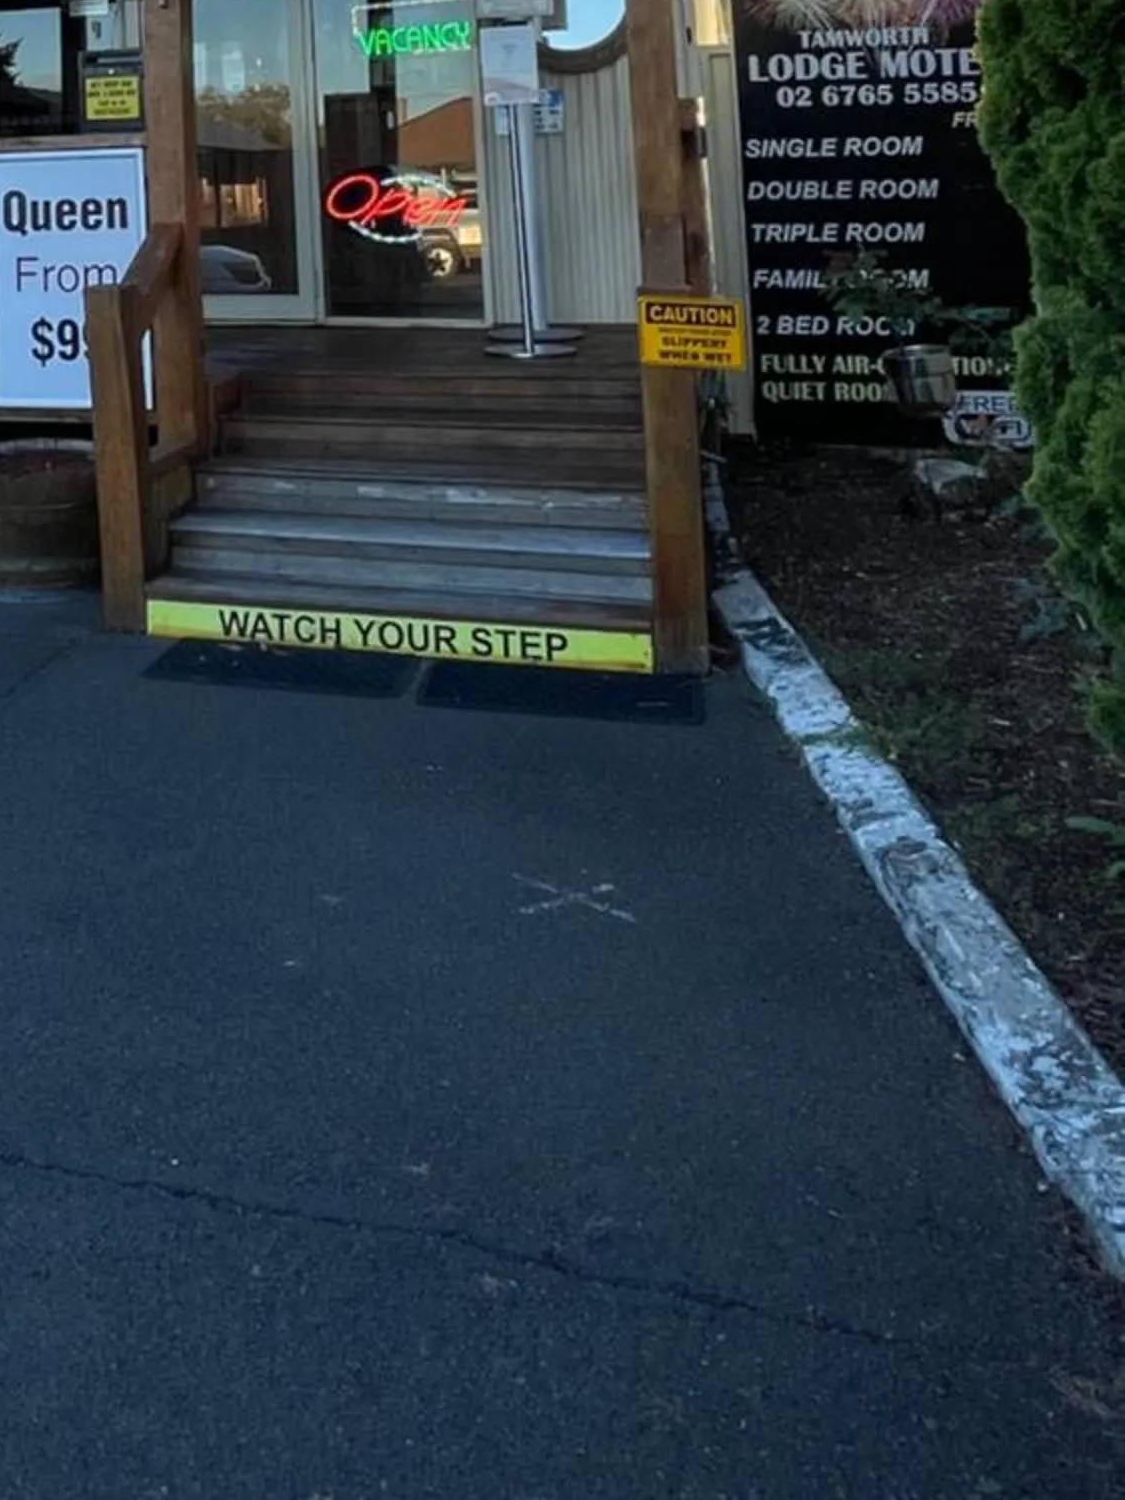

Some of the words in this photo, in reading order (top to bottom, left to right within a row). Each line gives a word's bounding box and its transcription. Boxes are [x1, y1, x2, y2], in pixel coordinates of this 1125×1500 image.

[357, 21, 470, 55] VACANCY
[799, 26, 930, 49] TAMWORTH
[747, 53, 869, 83] LODGE
[879, 48, 981, 78] MOTE
[776, 86, 814, 107] 02
[820, 84, 894, 106] 6765
[903, 81, 977, 104] 5585
[951, 111, 976, 129] FR
[745, 137, 837, 158] SINGLE
[842, 135, 924, 157] ROOM
[326, 173, 468, 227] Open
[747, 179, 854, 200] DOUBLE
[858, 178, 940, 199] ROOM
[2, 190, 129, 237] Queen
[751, 223, 839, 243] TRIPLE
[844, 221, 926, 243] ROOM
[16, 257, 118, 293] From
[753, 269, 839, 290] FAMIL
[650, 305, 733, 325] CAUTION
[756, 315, 771, 335] 2
[776, 314, 829, 336] BED
[31, 317, 88, 367] $9
[761, 354, 826, 374] FULLY
[762, 381, 827, 402] QUIET
[219, 610, 341, 646] WATCH
[353, 618, 459, 654] YOUR
[470, 627, 569, 662] STEP
